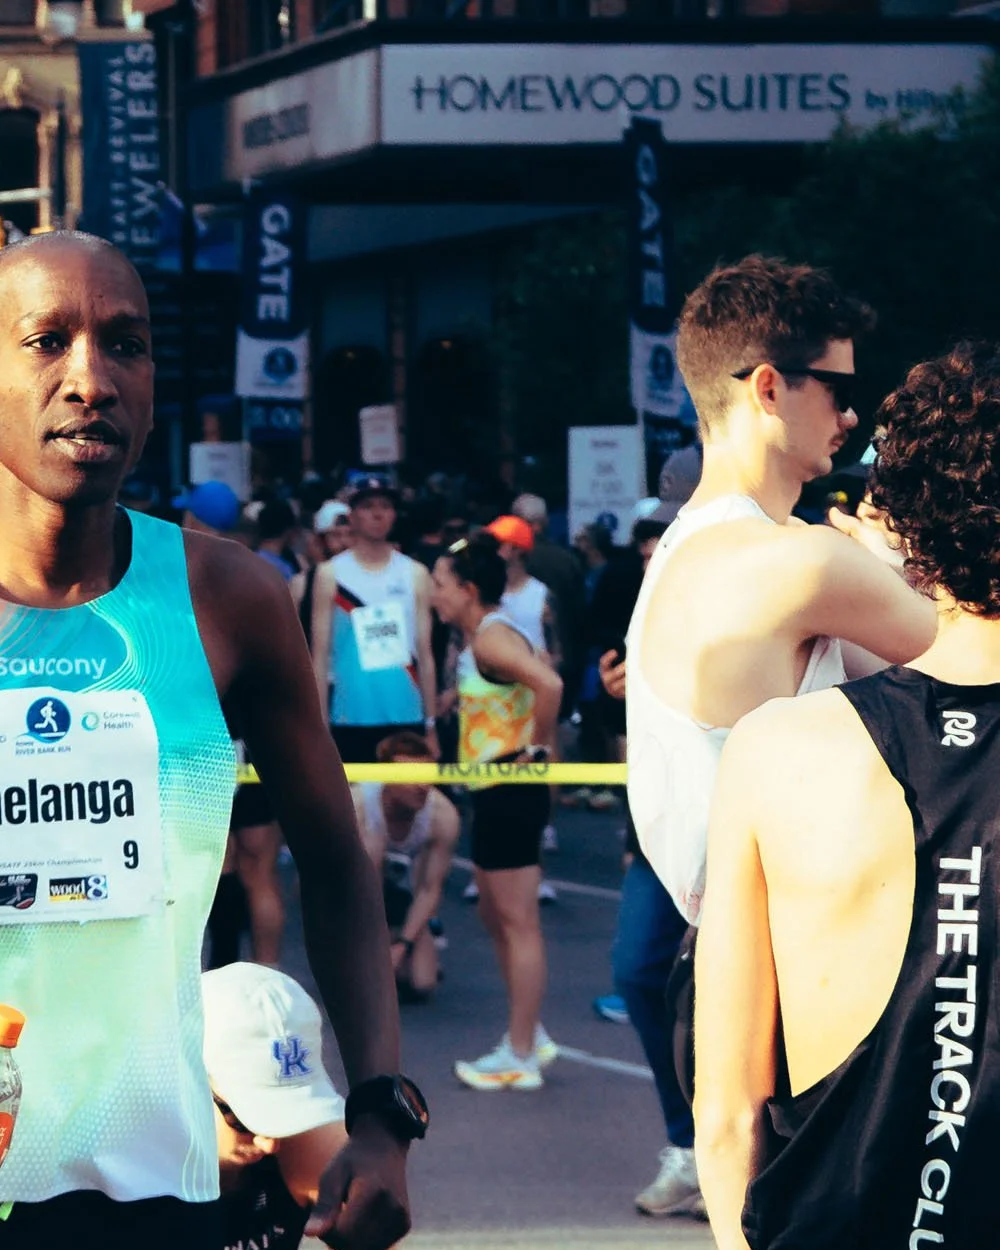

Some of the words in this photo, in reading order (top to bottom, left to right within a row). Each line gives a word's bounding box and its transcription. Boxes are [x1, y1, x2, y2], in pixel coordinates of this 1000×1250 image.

[410, 73, 681, 112] HOMEWOOD
[693, 72, 851, 112] SUITES
[257, 203, 291, 322] GATE
[634, 143, 666, 307] GATE
[122, 840, 139, 869] 9
[936, 846, 983, 956] THE
[271, 1034, 312, 1077] UK
[925, 964, 977, 1153] TRACK
